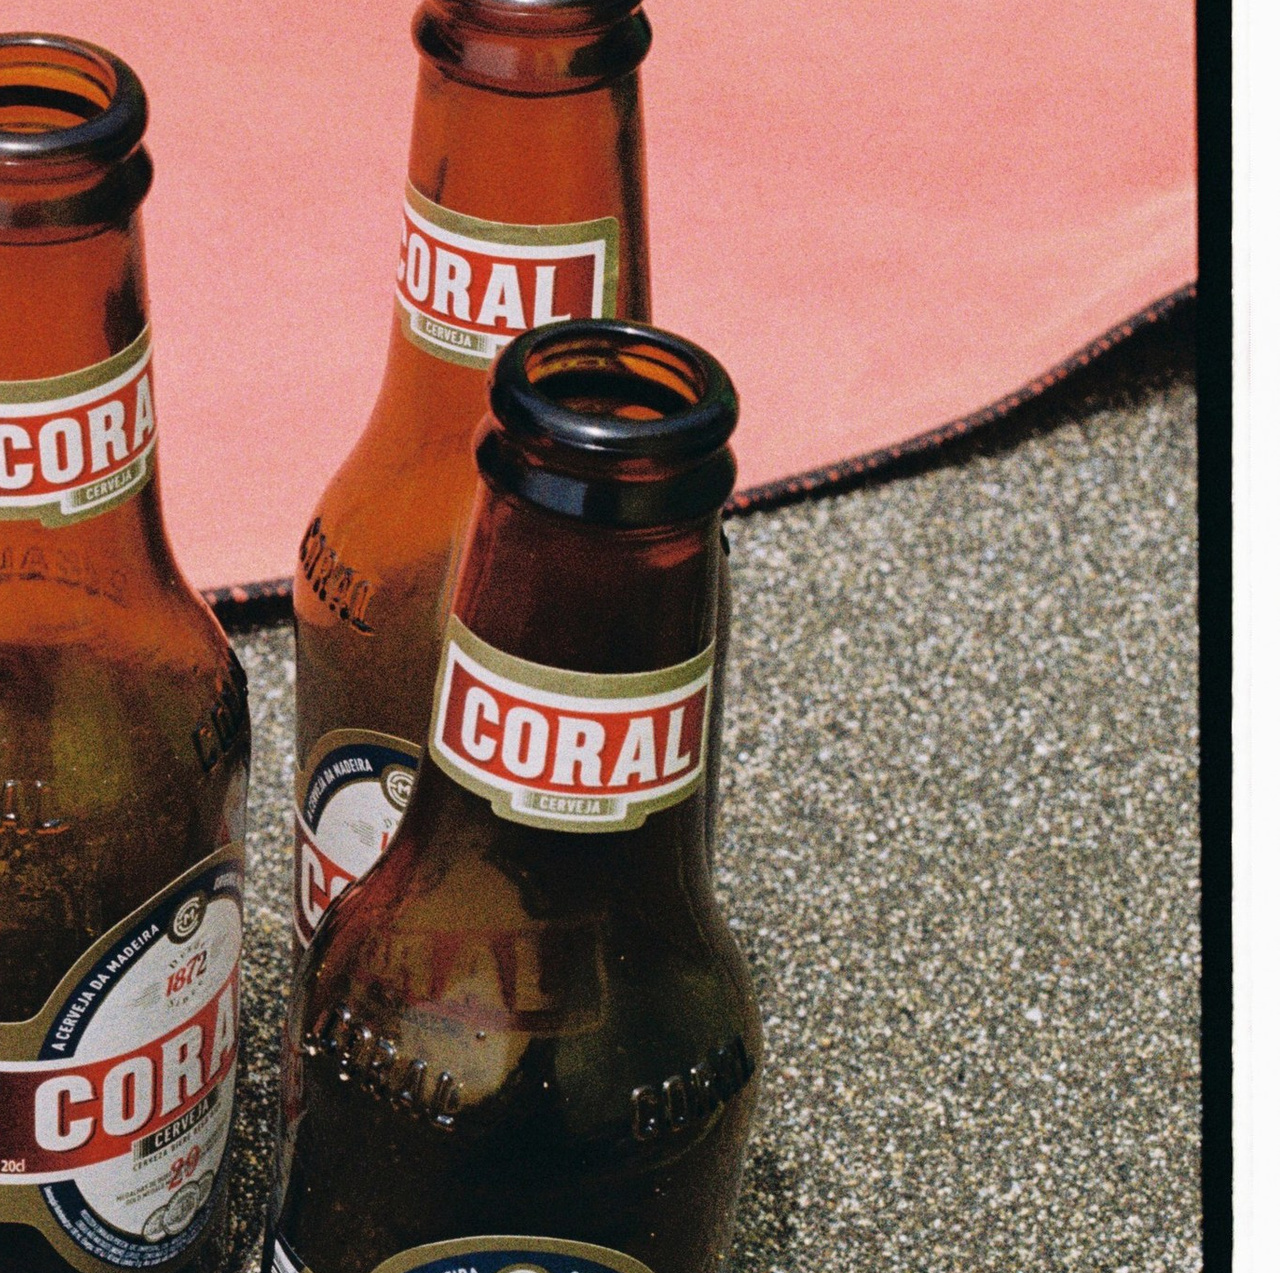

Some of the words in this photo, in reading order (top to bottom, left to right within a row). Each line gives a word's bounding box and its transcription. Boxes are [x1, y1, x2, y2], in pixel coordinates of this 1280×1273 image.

[425, 320, 472, 348] CERVEJA
[85, 469, 135, 501] CERVEJA
[461, 685, 691, 788] CORAL
[332, 757, 374, 778] MADEIRA
[539, 796, 601, 814] CERVEJA
[106, 924, 160, 973] MADEIRA
[89, 973, 110, 990] DA
[166, 950, 207, 997] 1872
[55, 990, 96, 1040] CERVEJA
[51, 1043, 67, 1052] A
[154, 1098, 209, 1148] CERVEJA
[1, 1159, 26, 1173] 20cl
